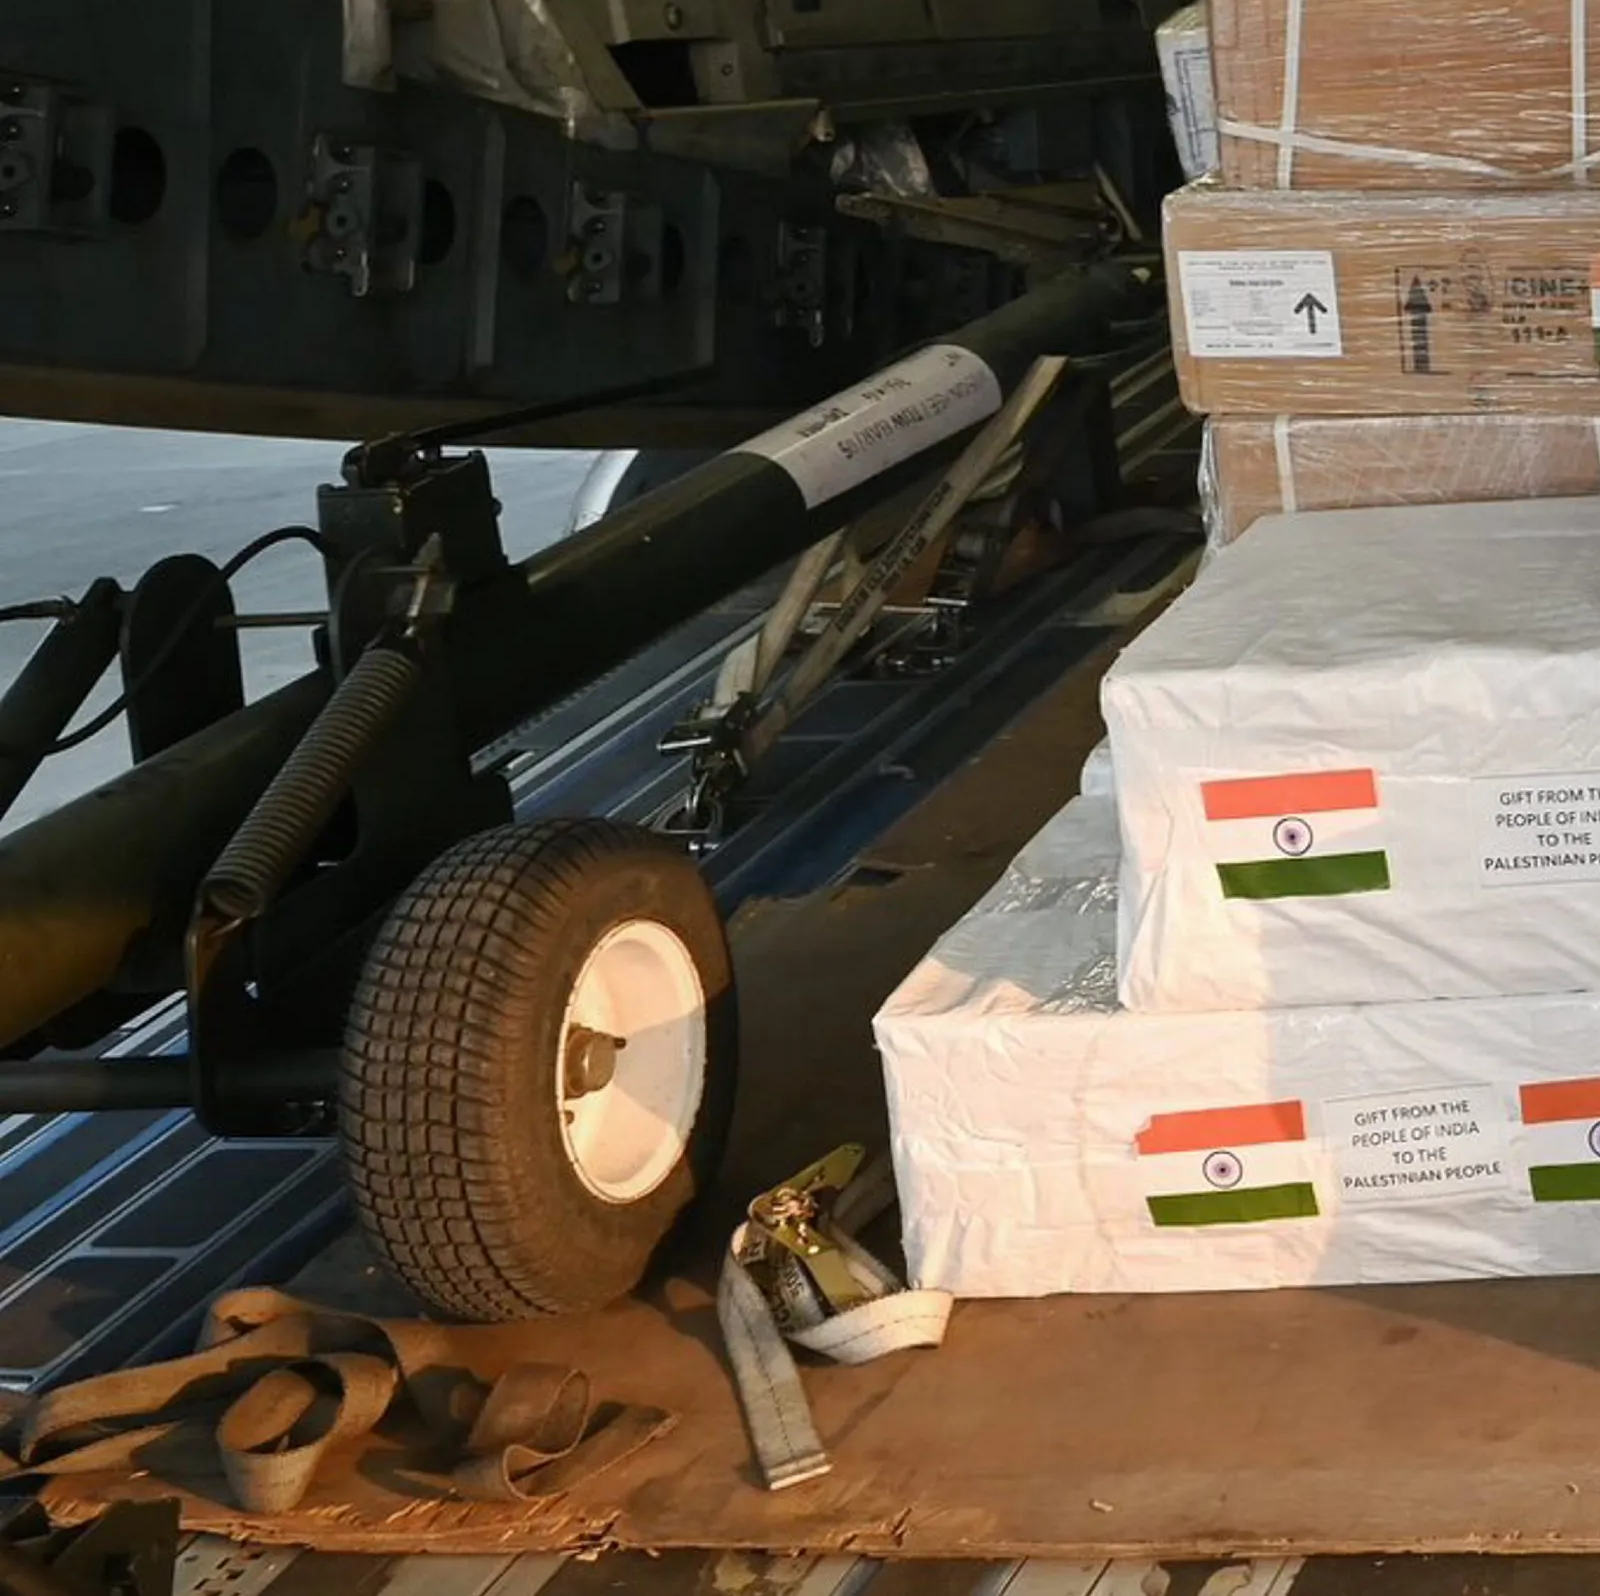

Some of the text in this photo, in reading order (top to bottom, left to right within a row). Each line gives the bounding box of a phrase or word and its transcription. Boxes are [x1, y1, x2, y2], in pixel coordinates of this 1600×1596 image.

[1500, 791, 1533, 806] GIFT
[1537, 788, 1584, 803] FROM
[1495, 811, 1552, 828] PEOPLE
[1555, 811, 1576, 825] OF
[1537, 832, 1592, 847] TO THE
[1484, 853, 1586, 870] PALESTINIAN
[1354, 1100, 1470, 1126] GIFT FROM THE
[1352, 1121, 1480, 1147] PEOPLE OF INDIA
[1392, 1146, 1446, 1164] TO THE
[1343, 1161, 1501, 1188] PALESTINIAN PEOPLE
